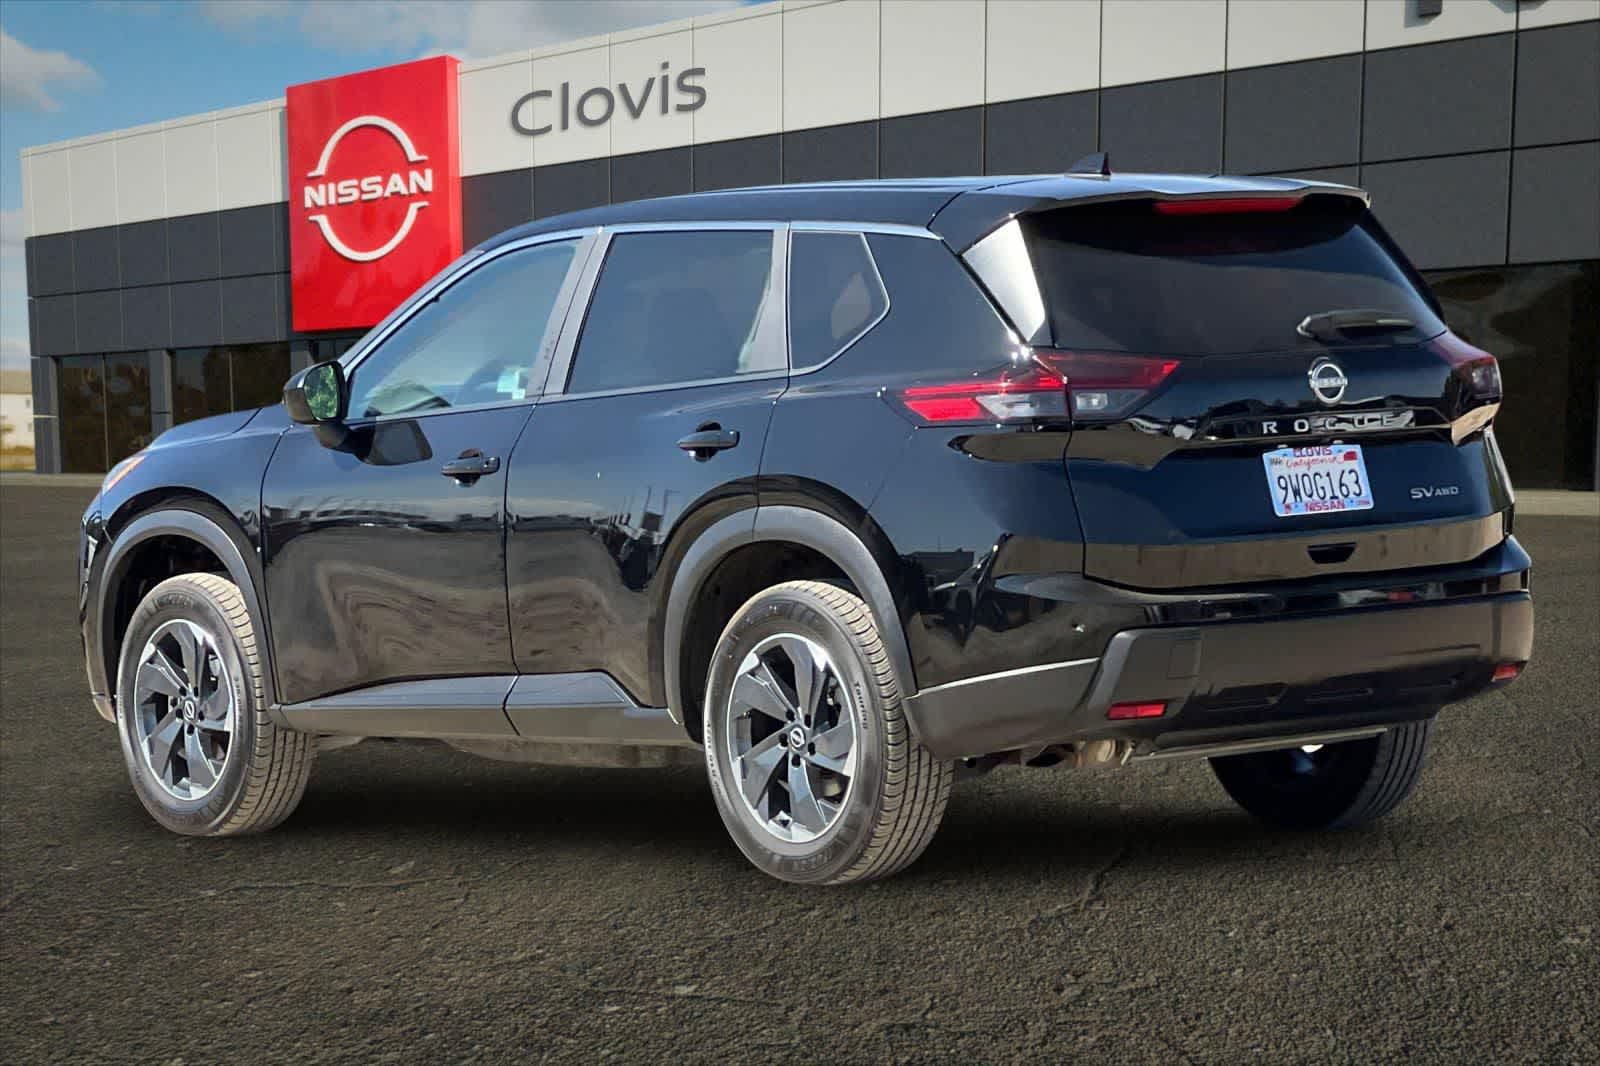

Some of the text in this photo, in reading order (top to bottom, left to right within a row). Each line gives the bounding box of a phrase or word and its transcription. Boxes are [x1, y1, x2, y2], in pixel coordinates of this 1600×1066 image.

[511, 61, 707, 136] Clovis
[304, 168, 433, 209] NISSAN
[1262, 414, 1394, 434] ROGUE
[1293, 446, 1332, 457] CLOVIS
[1305, 500, 1345, 512] NISSAN
